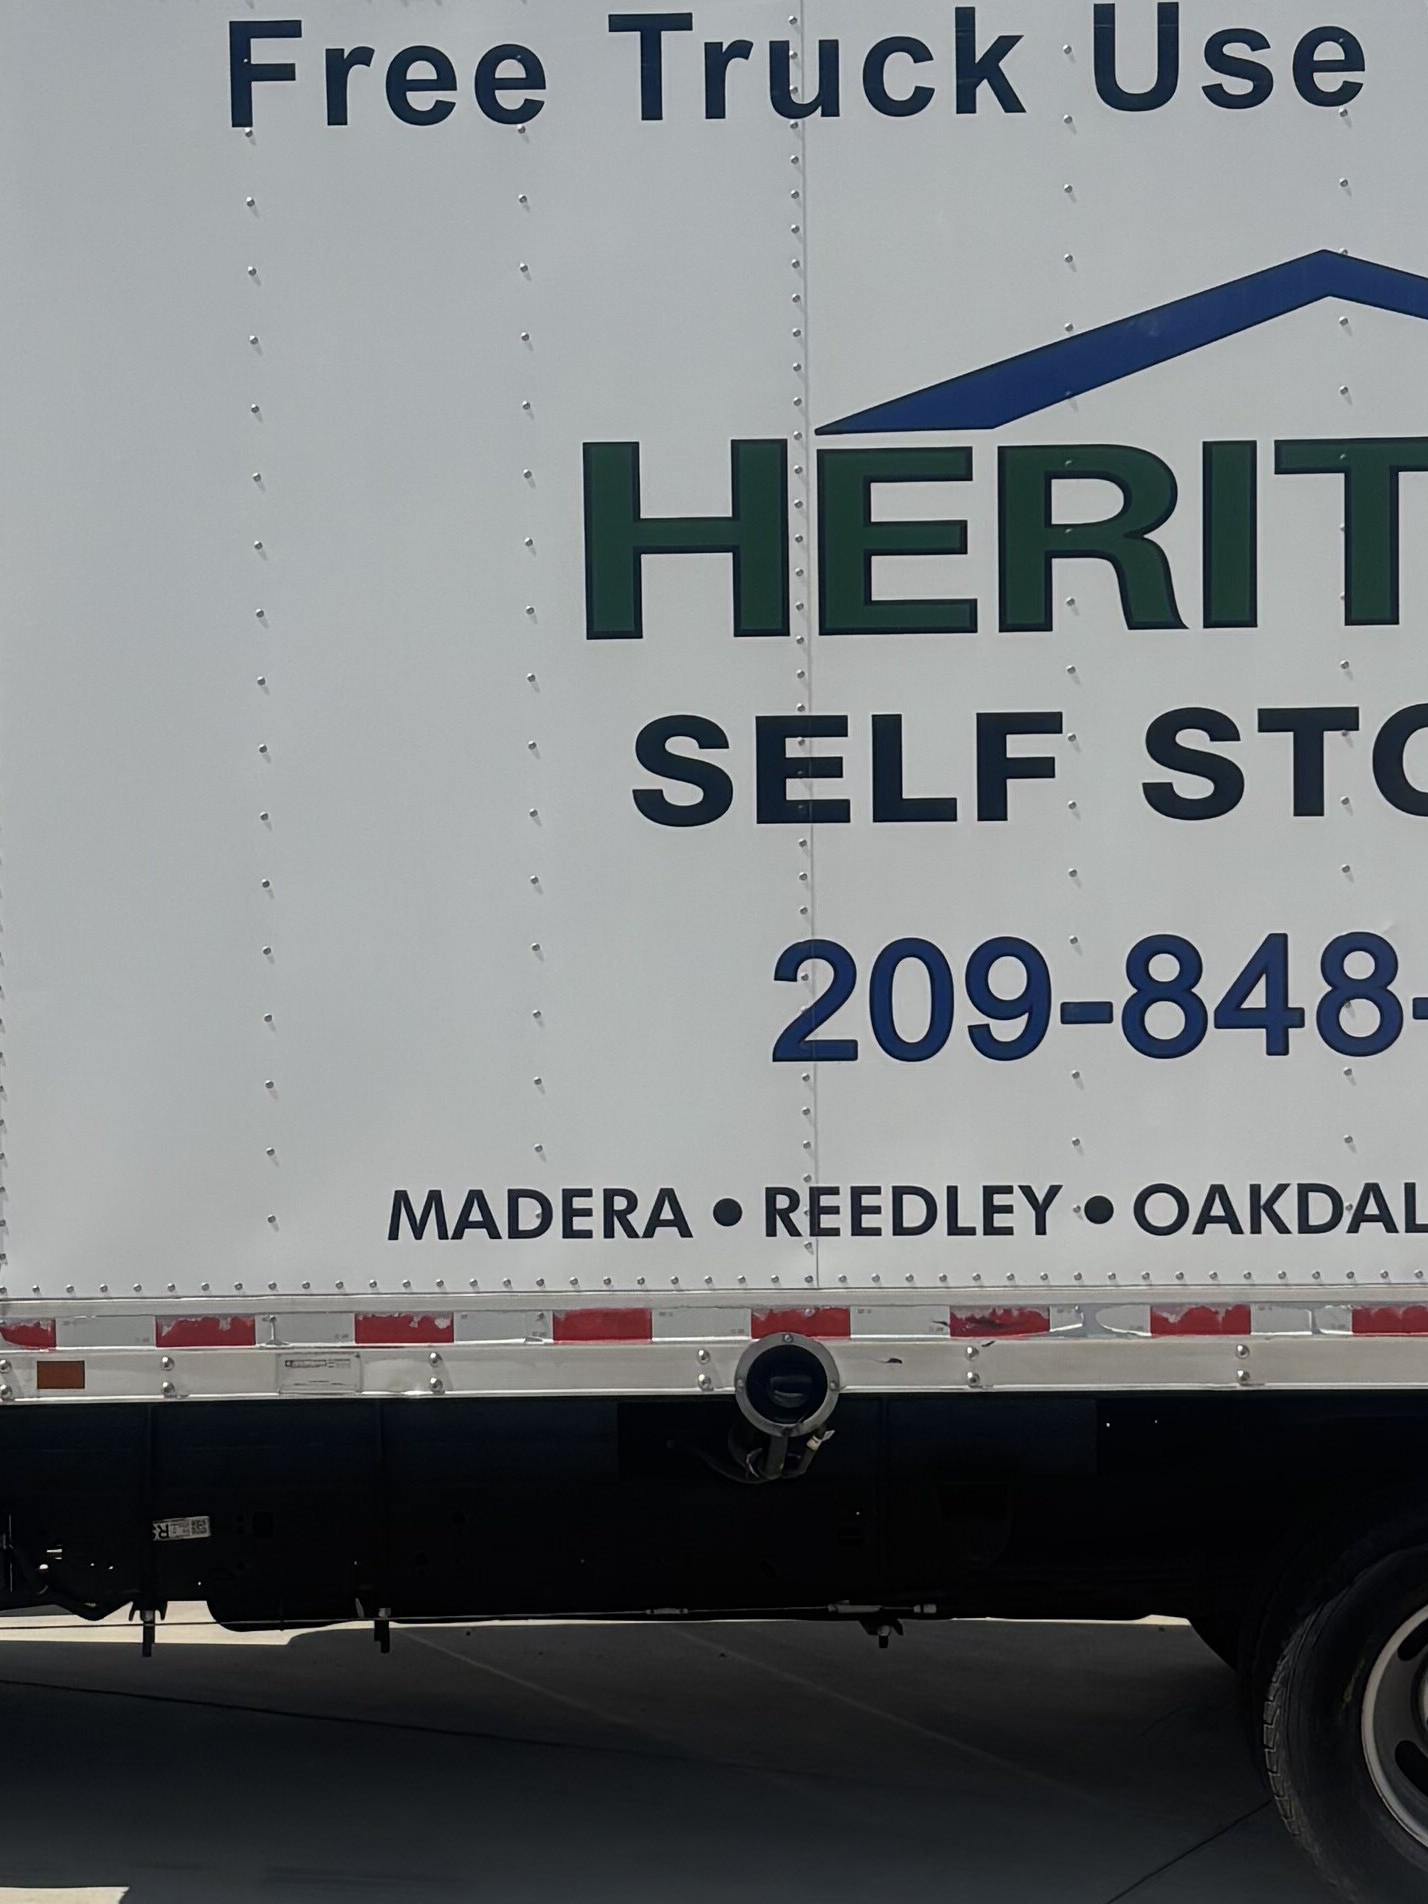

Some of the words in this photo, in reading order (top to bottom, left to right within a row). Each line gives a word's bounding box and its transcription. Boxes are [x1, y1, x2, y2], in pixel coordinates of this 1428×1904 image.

[229, 20, 546, 127] Free
[608, 7, 1026, 120] Truck
[1094, 2, 1365, 111] Use
[632, 712, 1062, 827] SELF
[388, 1188, 693, 1240] MADERA
[765, 1185, 1062, 1237] REEDLEY
